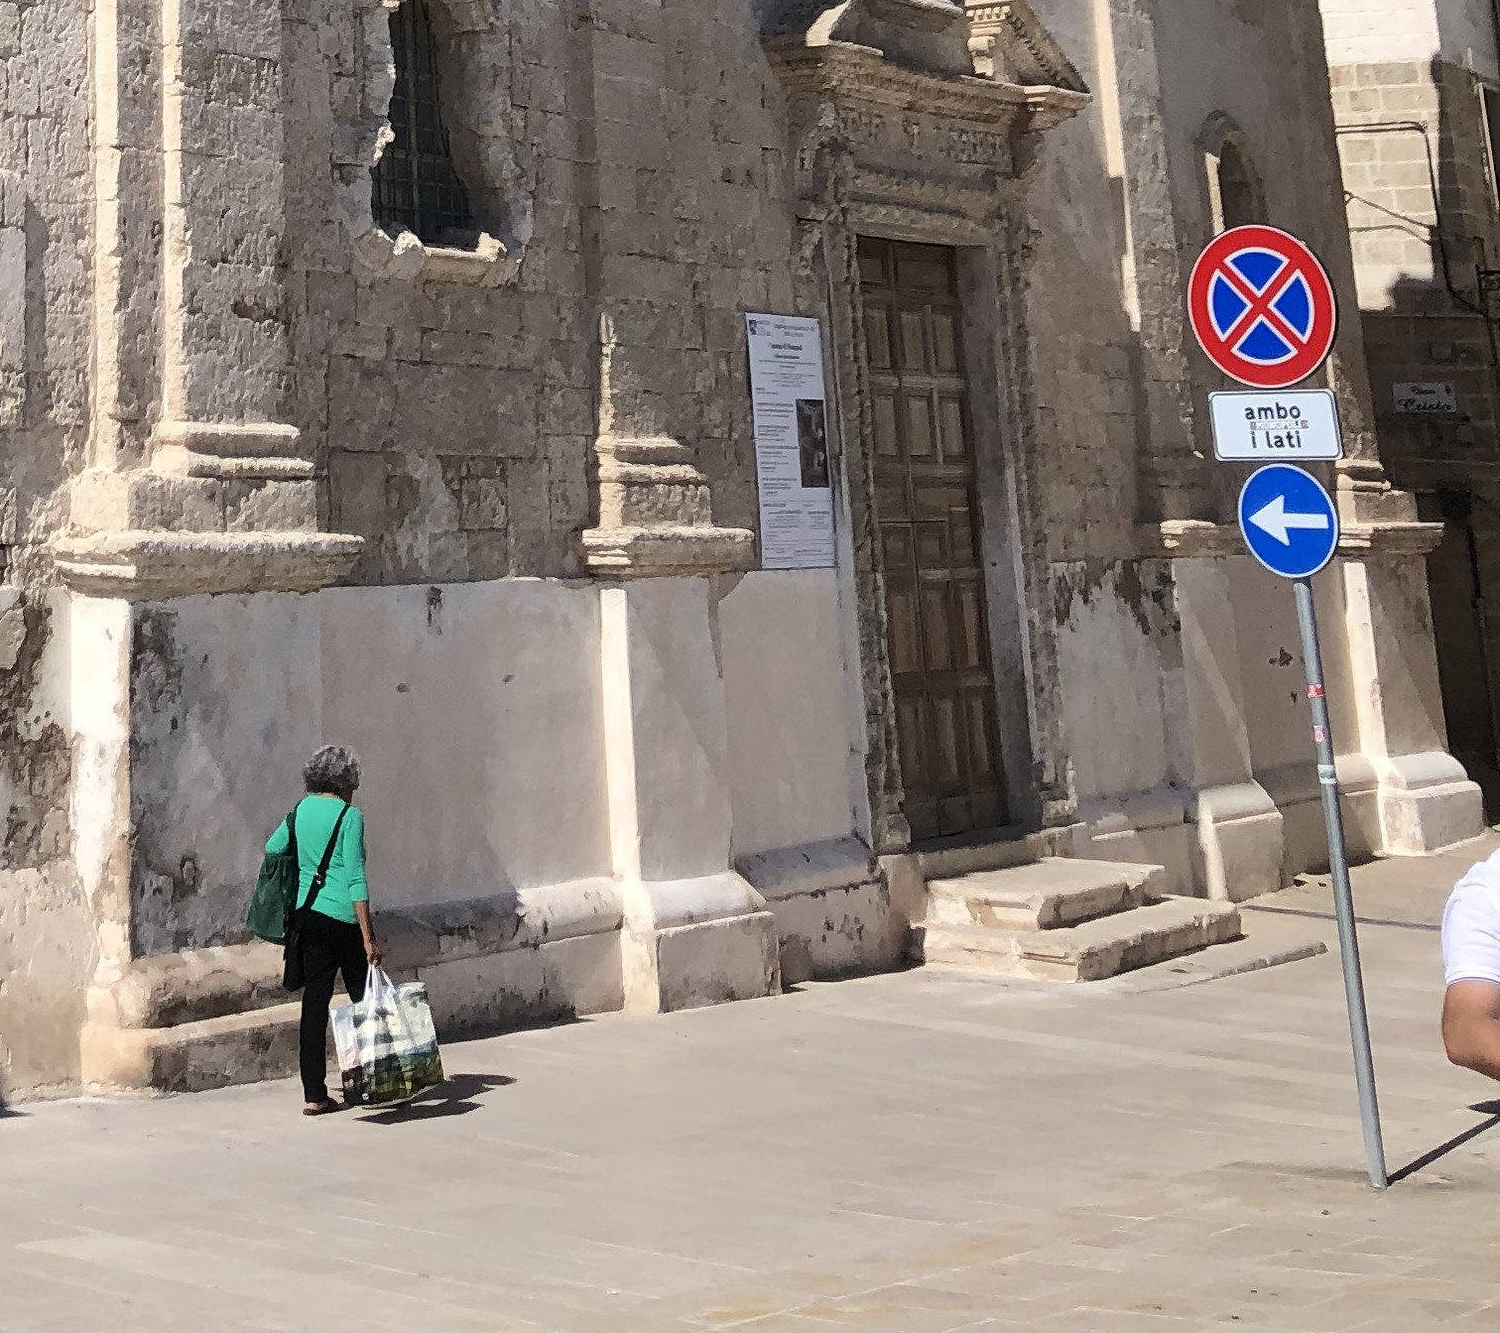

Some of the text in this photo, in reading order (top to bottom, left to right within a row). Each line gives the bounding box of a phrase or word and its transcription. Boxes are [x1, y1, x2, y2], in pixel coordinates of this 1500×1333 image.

[1244, 401, 1301, 420] ambo
[1250, 430, 1302, 448] i lati
